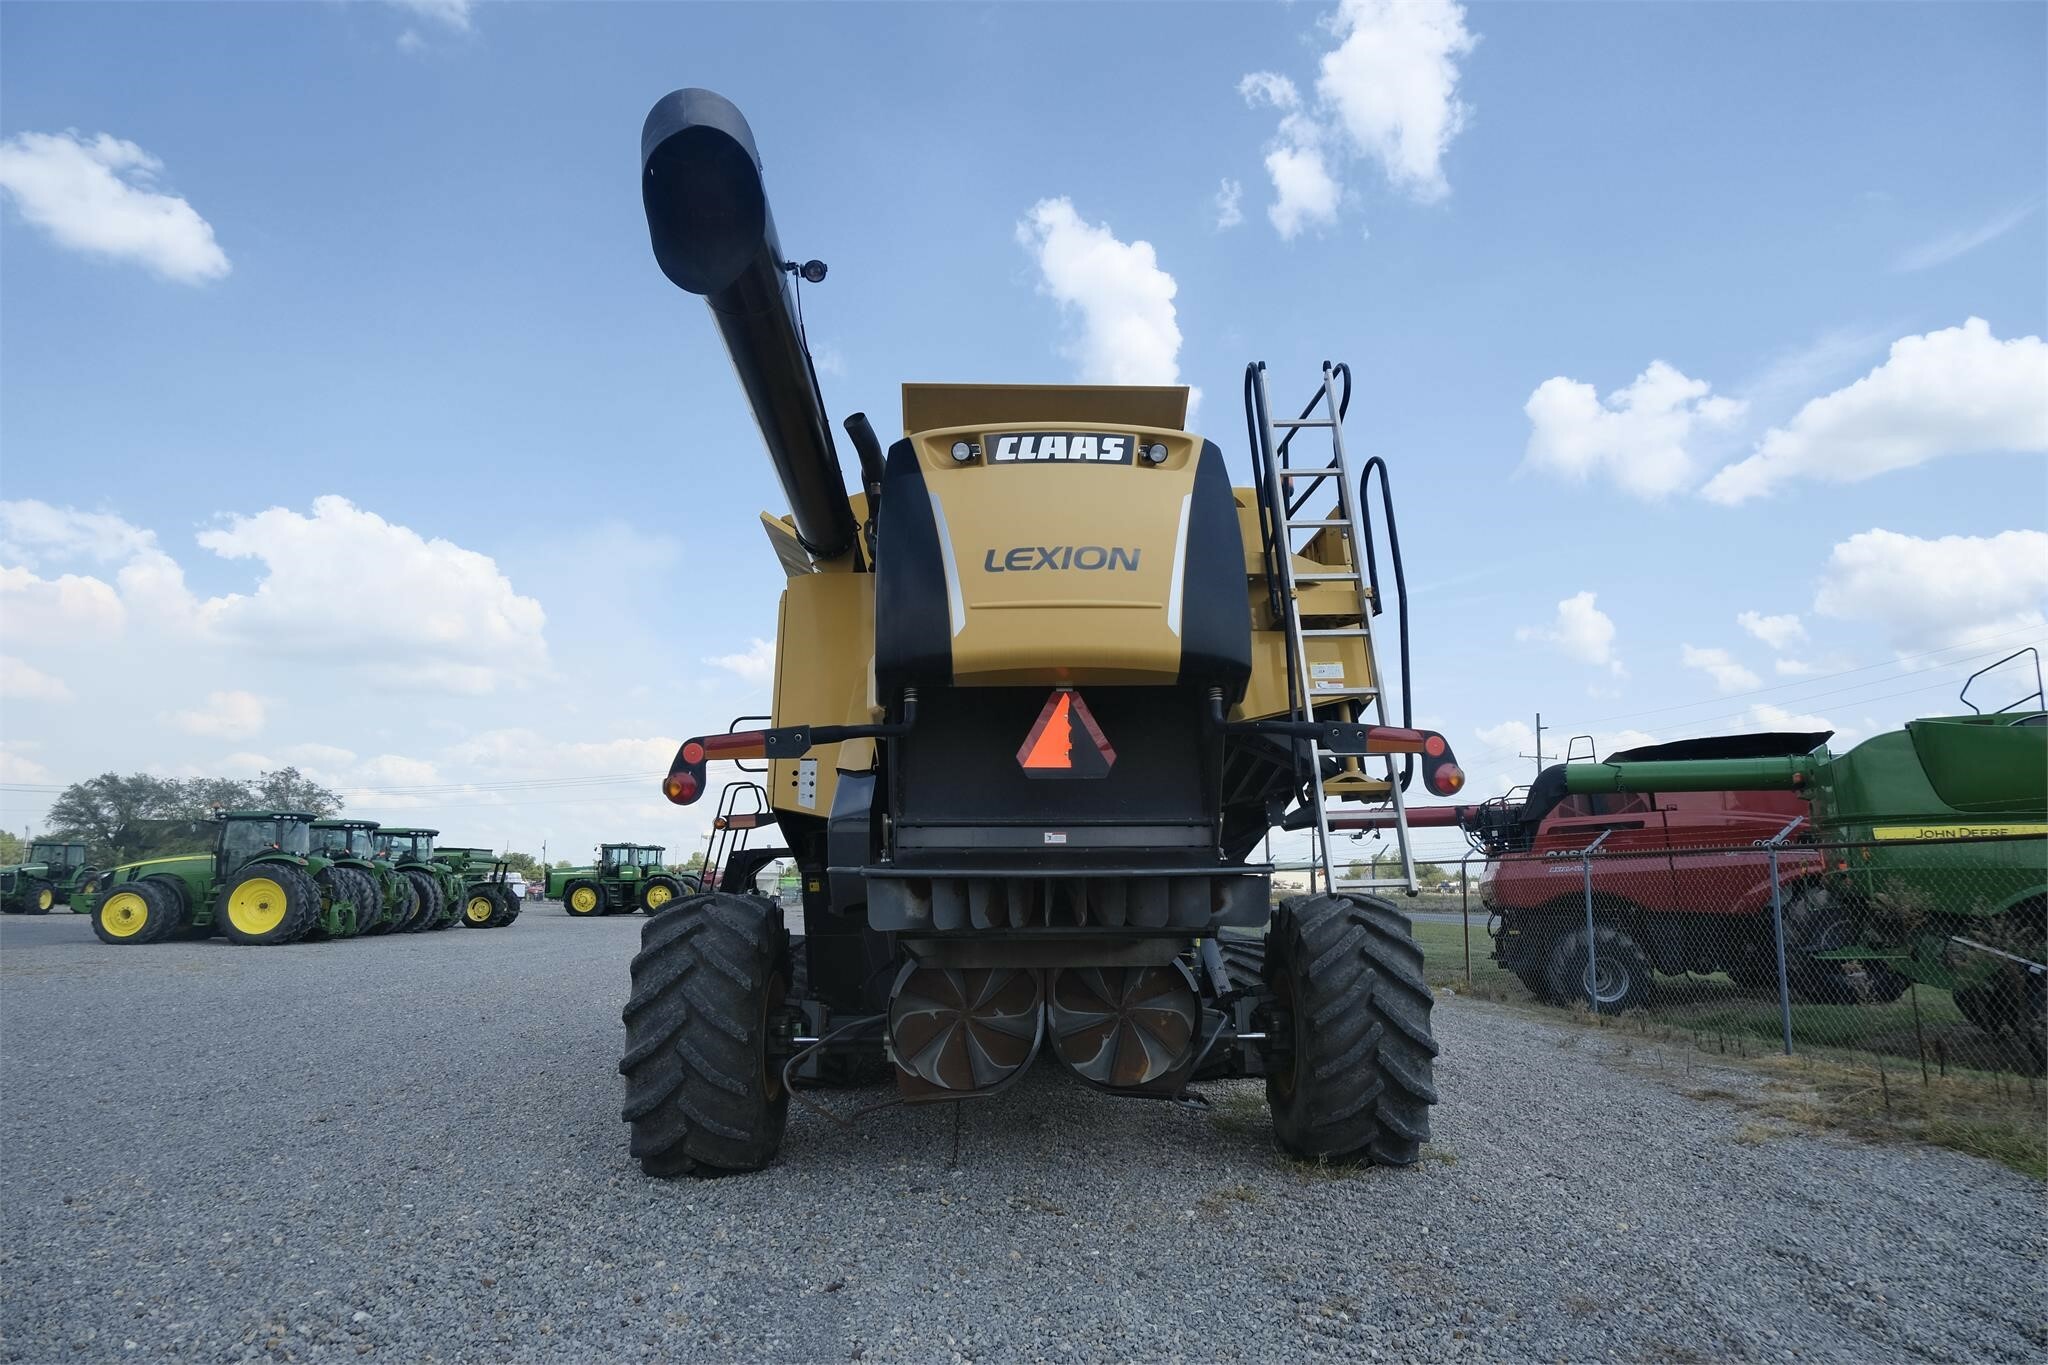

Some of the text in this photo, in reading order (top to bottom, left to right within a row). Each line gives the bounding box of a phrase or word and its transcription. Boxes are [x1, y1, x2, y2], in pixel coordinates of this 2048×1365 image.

[995, 436, 1125, 461] CLAAS
[984, 546, 1142, 573] LEXION
[1915, 827, 2009, 839] JOHN DEERE
